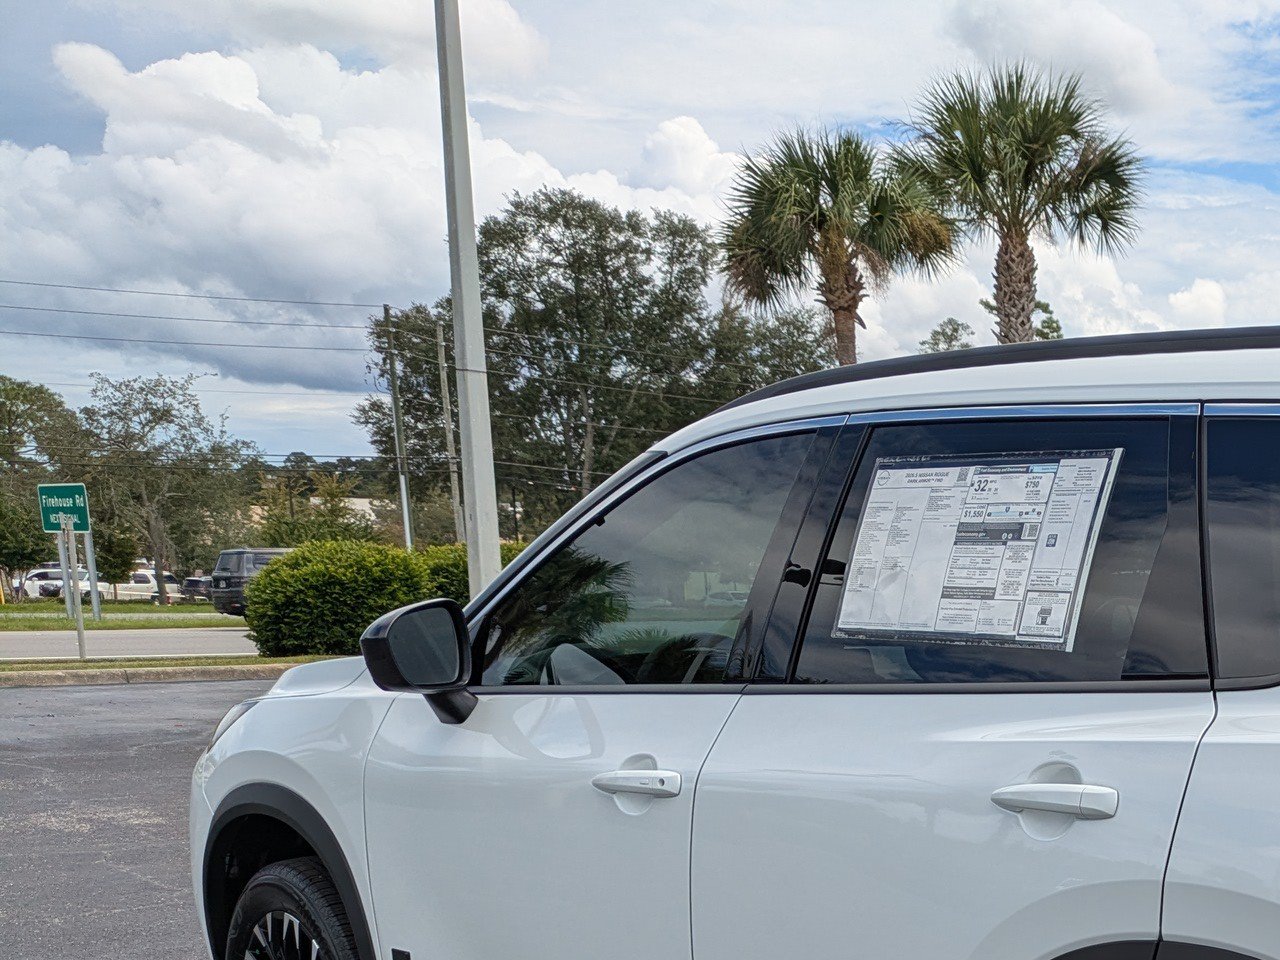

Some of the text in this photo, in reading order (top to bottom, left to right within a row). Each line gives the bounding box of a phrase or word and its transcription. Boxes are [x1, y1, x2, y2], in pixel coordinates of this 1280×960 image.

[974, 479, 989, 492] 32
[1024, 481, 1040, 489] $750
[42, 494, 84, 507] Firehouse Rd
[963, 510, 984, 519] $1,550
